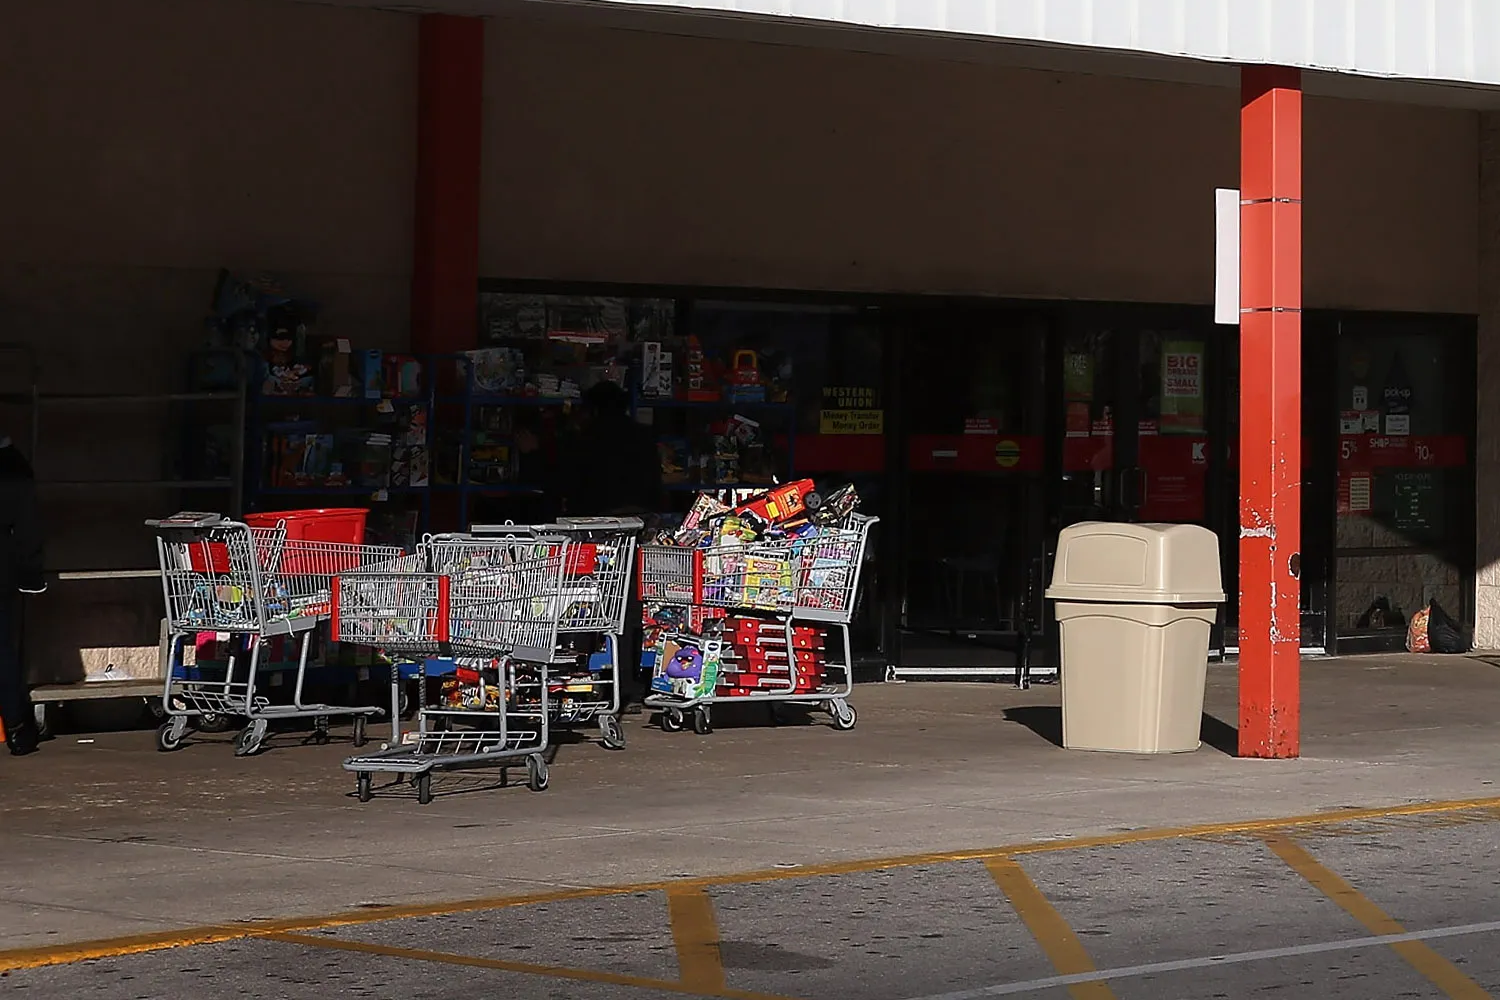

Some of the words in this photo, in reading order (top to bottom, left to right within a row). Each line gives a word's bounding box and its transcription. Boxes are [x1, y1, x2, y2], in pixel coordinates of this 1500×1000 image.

[1168, 356, 1198, 368] BIG
[1167, 379, 1198, 387] SMALL
[822, 386, 873, 397] WESTERN
[837, 397, 873, 408] UNION
